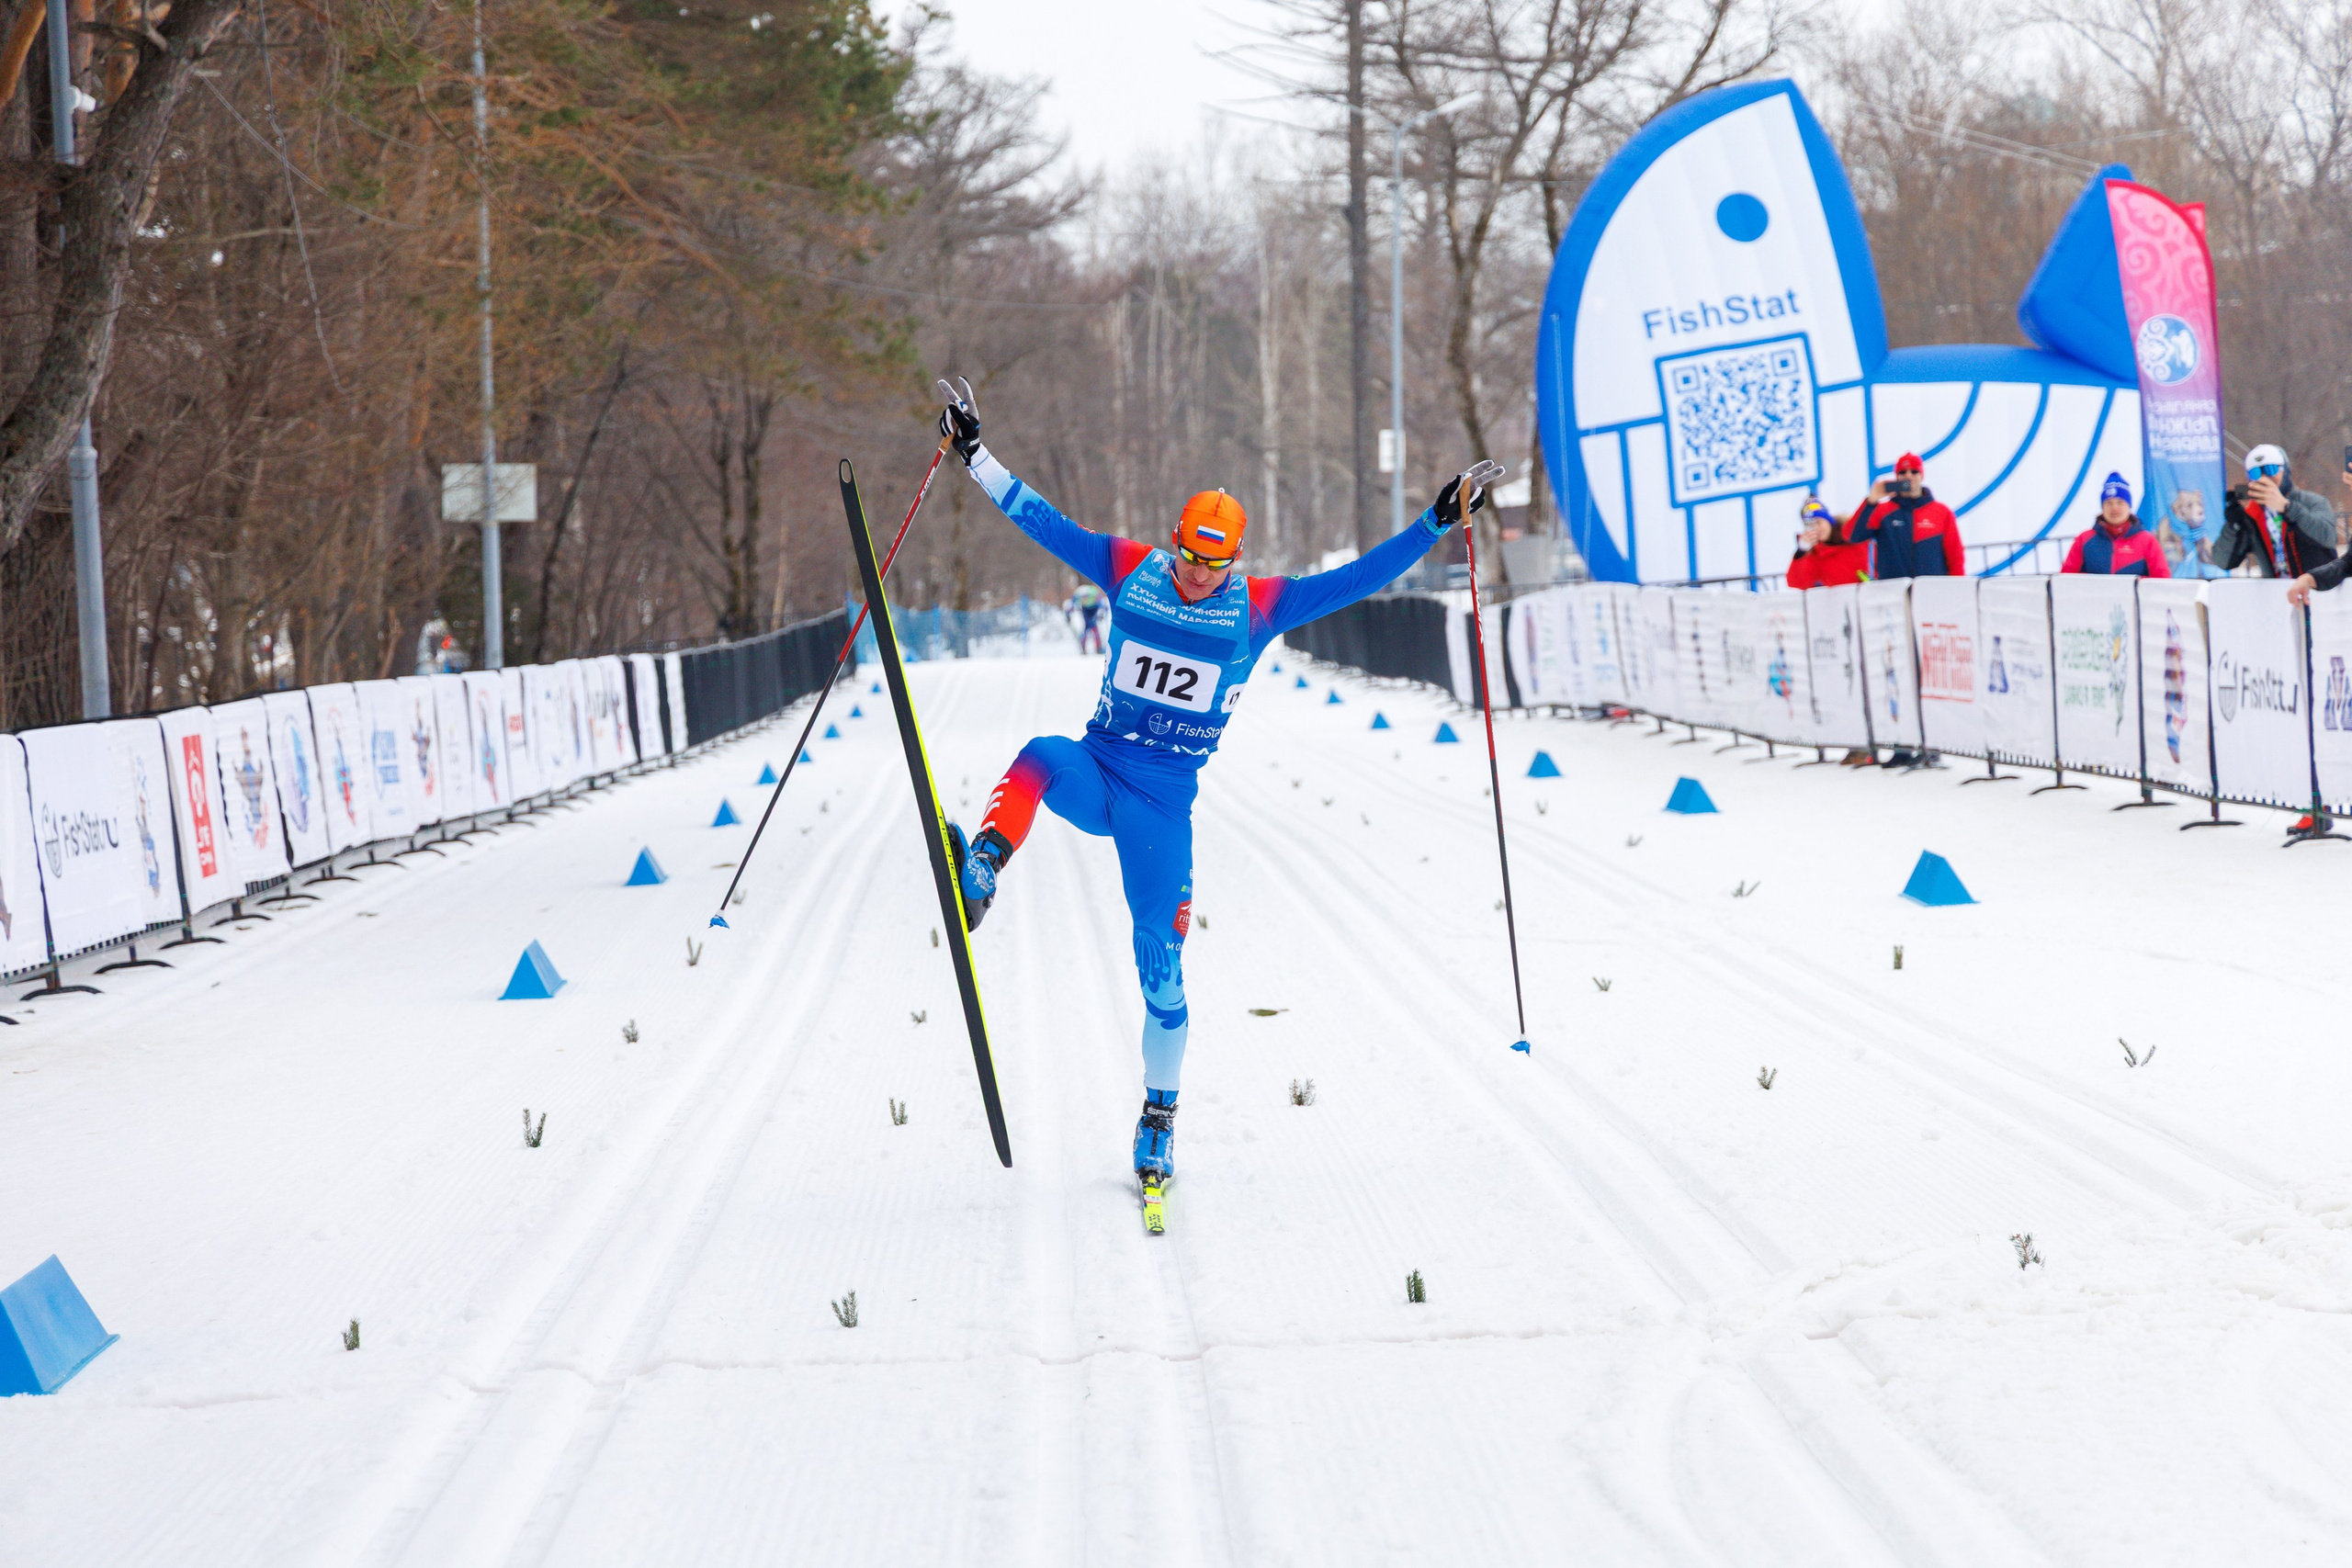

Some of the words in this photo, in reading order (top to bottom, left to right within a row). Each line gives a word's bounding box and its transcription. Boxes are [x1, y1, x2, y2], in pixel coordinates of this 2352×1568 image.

[1642, 288, 1800, 340] FishStat
[1140, 570, 1162, 584] RUSSIA
[1127, 592, 1176, 616] ЛЫЖНЫЙ
[1178, 613, 1235, 628] МАРАФОН
[1135, 656, 1198, 702] 112
[1175, 723, 1225, 739] FishStat
